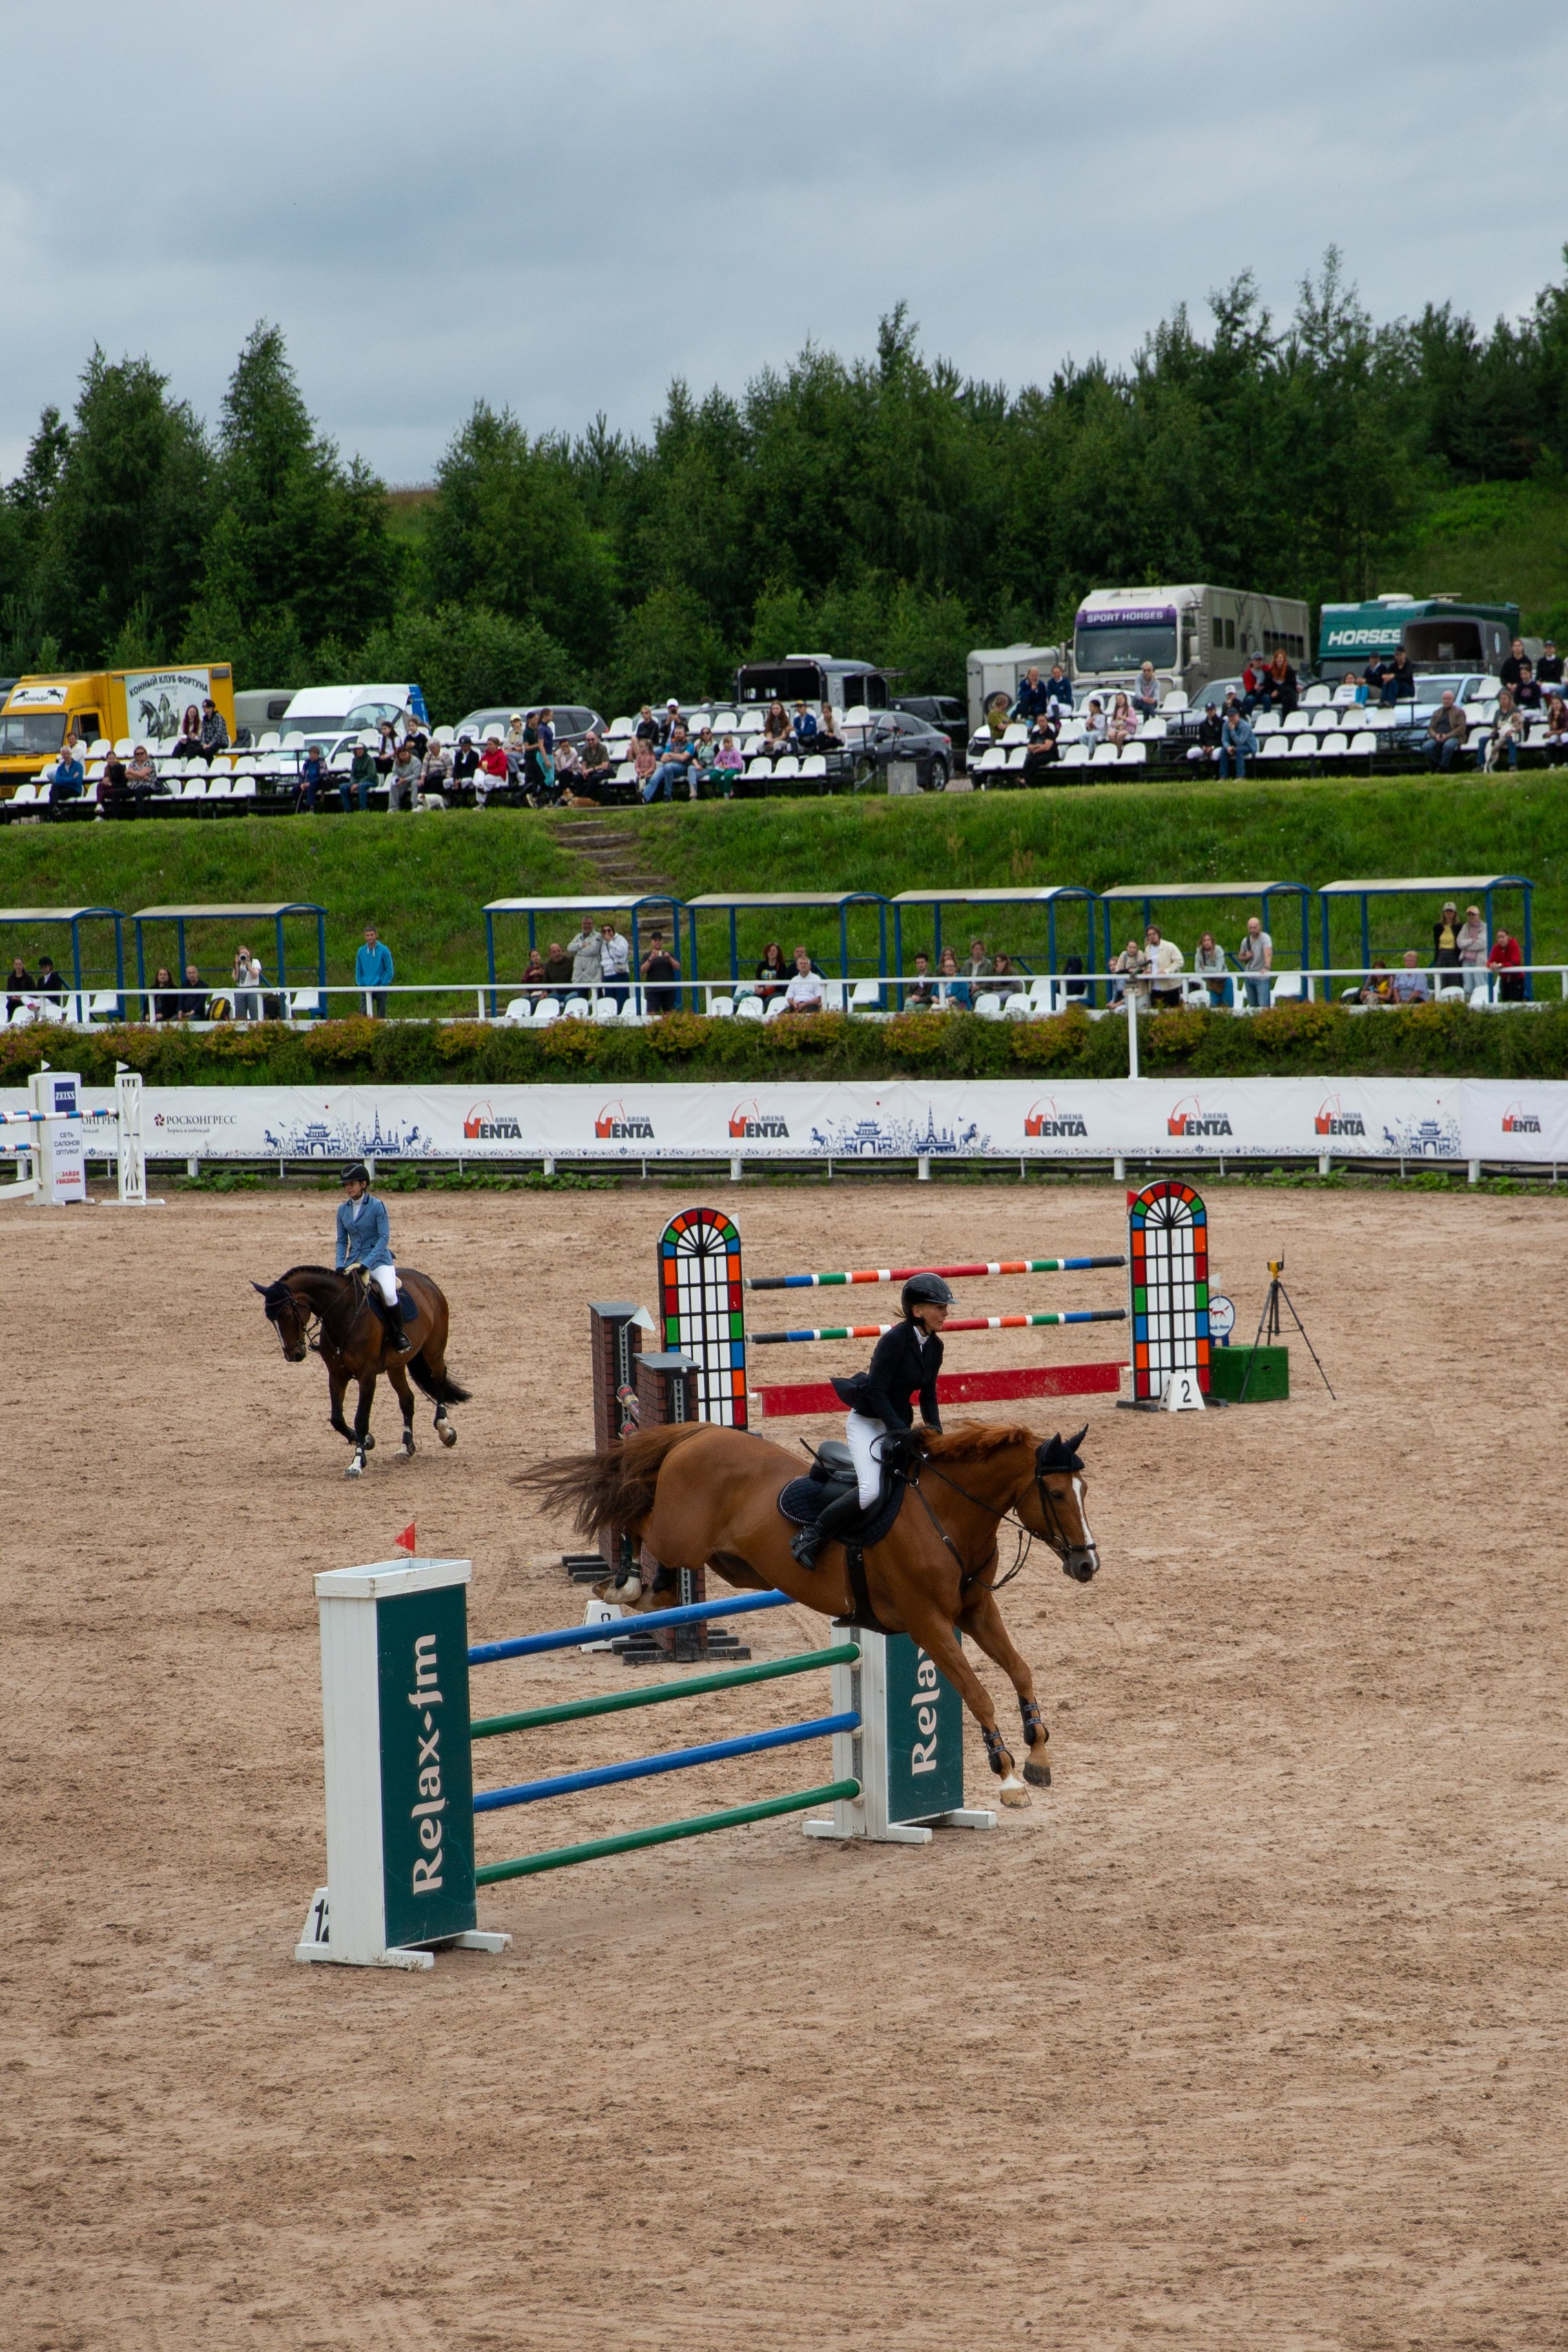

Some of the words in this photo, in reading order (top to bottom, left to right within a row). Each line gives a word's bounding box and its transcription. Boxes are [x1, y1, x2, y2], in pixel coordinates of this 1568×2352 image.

[1086, 612, 1120, 623] SPORT
[1122, 610, 1164, 621] HORSES
[1328, 628, 1401, 646] HORSES
[130, 674, 158, 698] КОННЫЙ
[158, 674, 176, 684] КЛУБ
[178, 675, 208, 693] ФОРТУНА
[55, 1091, 75, 1101] ZEISS
[166, 1115, 237, 1125] РОСКОНГРЕСС
[464, 1117, 522, 1139] VENTA
[595, 1117, 654, 1138] VENTA
[728, 1116, 790, 1137] VENTA
[1024, 1114, 1088, 1137] VENTA
[1167, 1113, 1232, 1136] VENTA
[1314, 1113, 1365, 1136] VENTA
[1502, 1115, 1541, 1133] VENTA
[54, 1139, 81, 1148] САЛОНОВ
[1163, 1379, 1170, 1403] 2
[1181, 1379, 1192, 1403] 2
[911, 1647, 940, 1777] Rela
